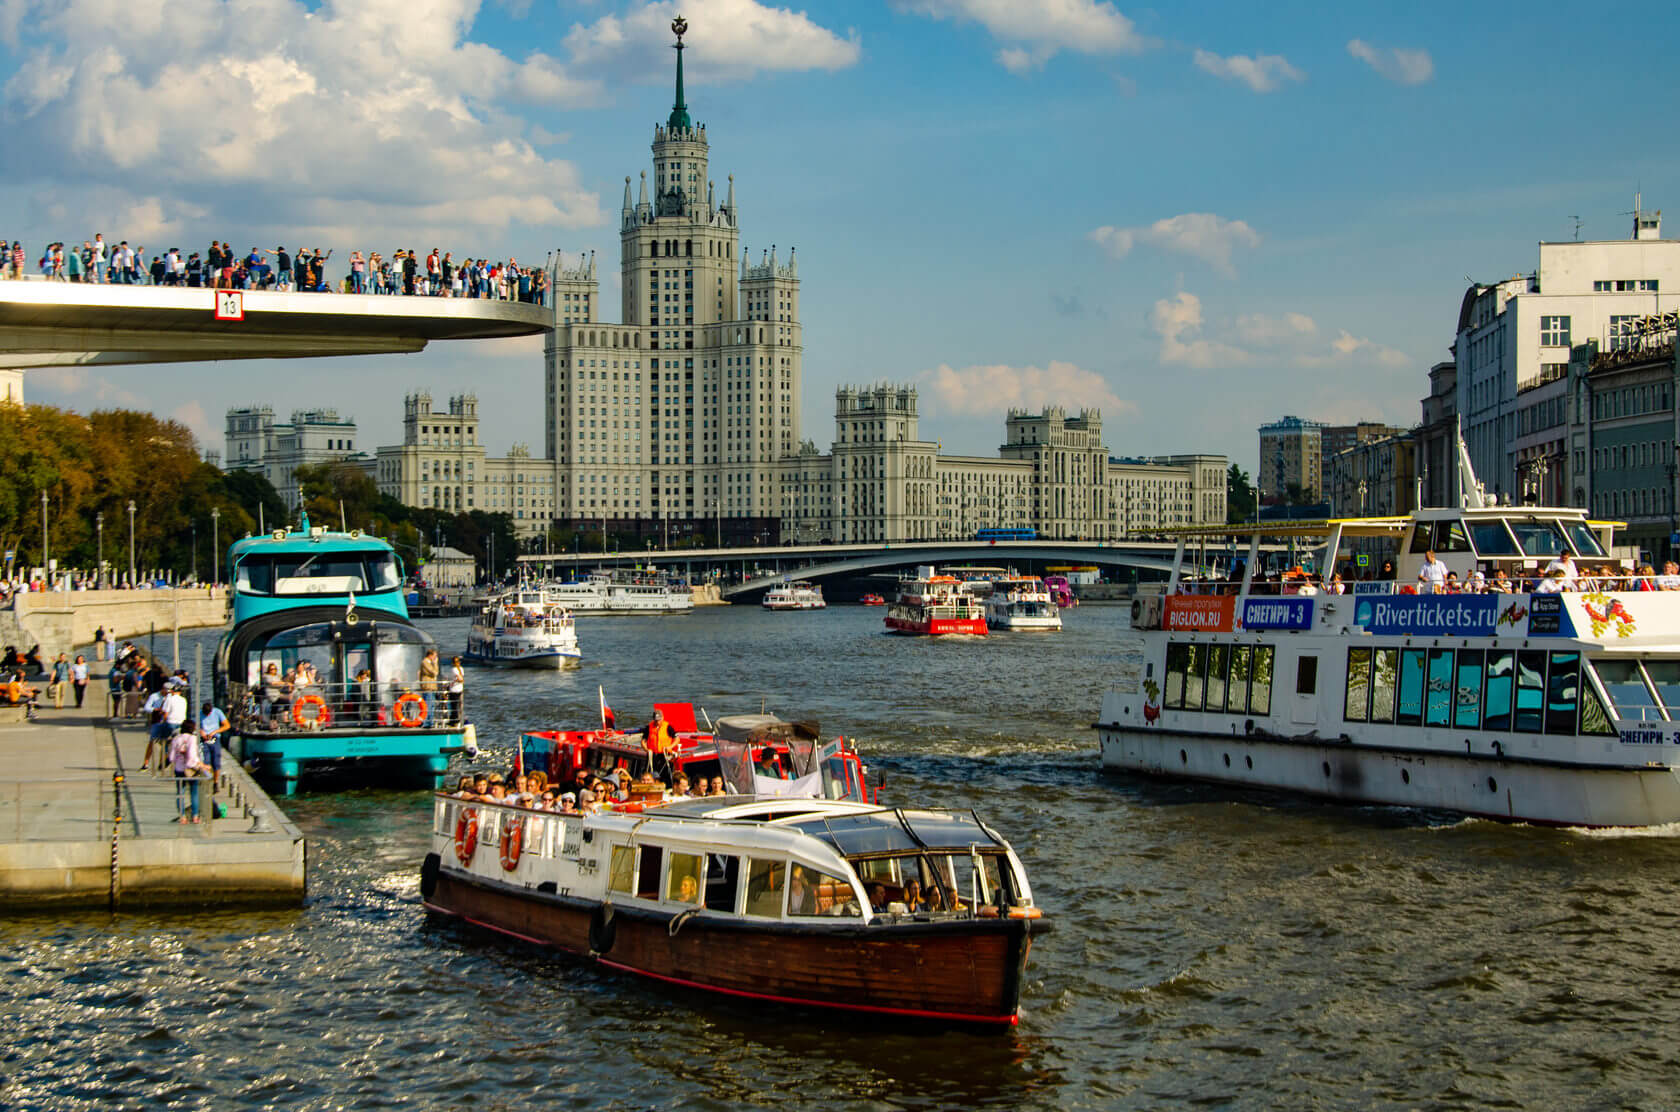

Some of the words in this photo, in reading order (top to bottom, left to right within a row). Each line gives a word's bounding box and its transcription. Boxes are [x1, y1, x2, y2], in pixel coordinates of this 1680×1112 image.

[223, 300, 237, 315] 13
[1169, 610, 1221, 628] BIGLION.RU
[1246, 604, 1290, 624] СНЕГИРИ
[1296, 605, 1304, 624] 3
[1375, 602, 1497, 628] Rivertickets.ru
[1619, 729, 1664, 745] СНЕГИРИ
